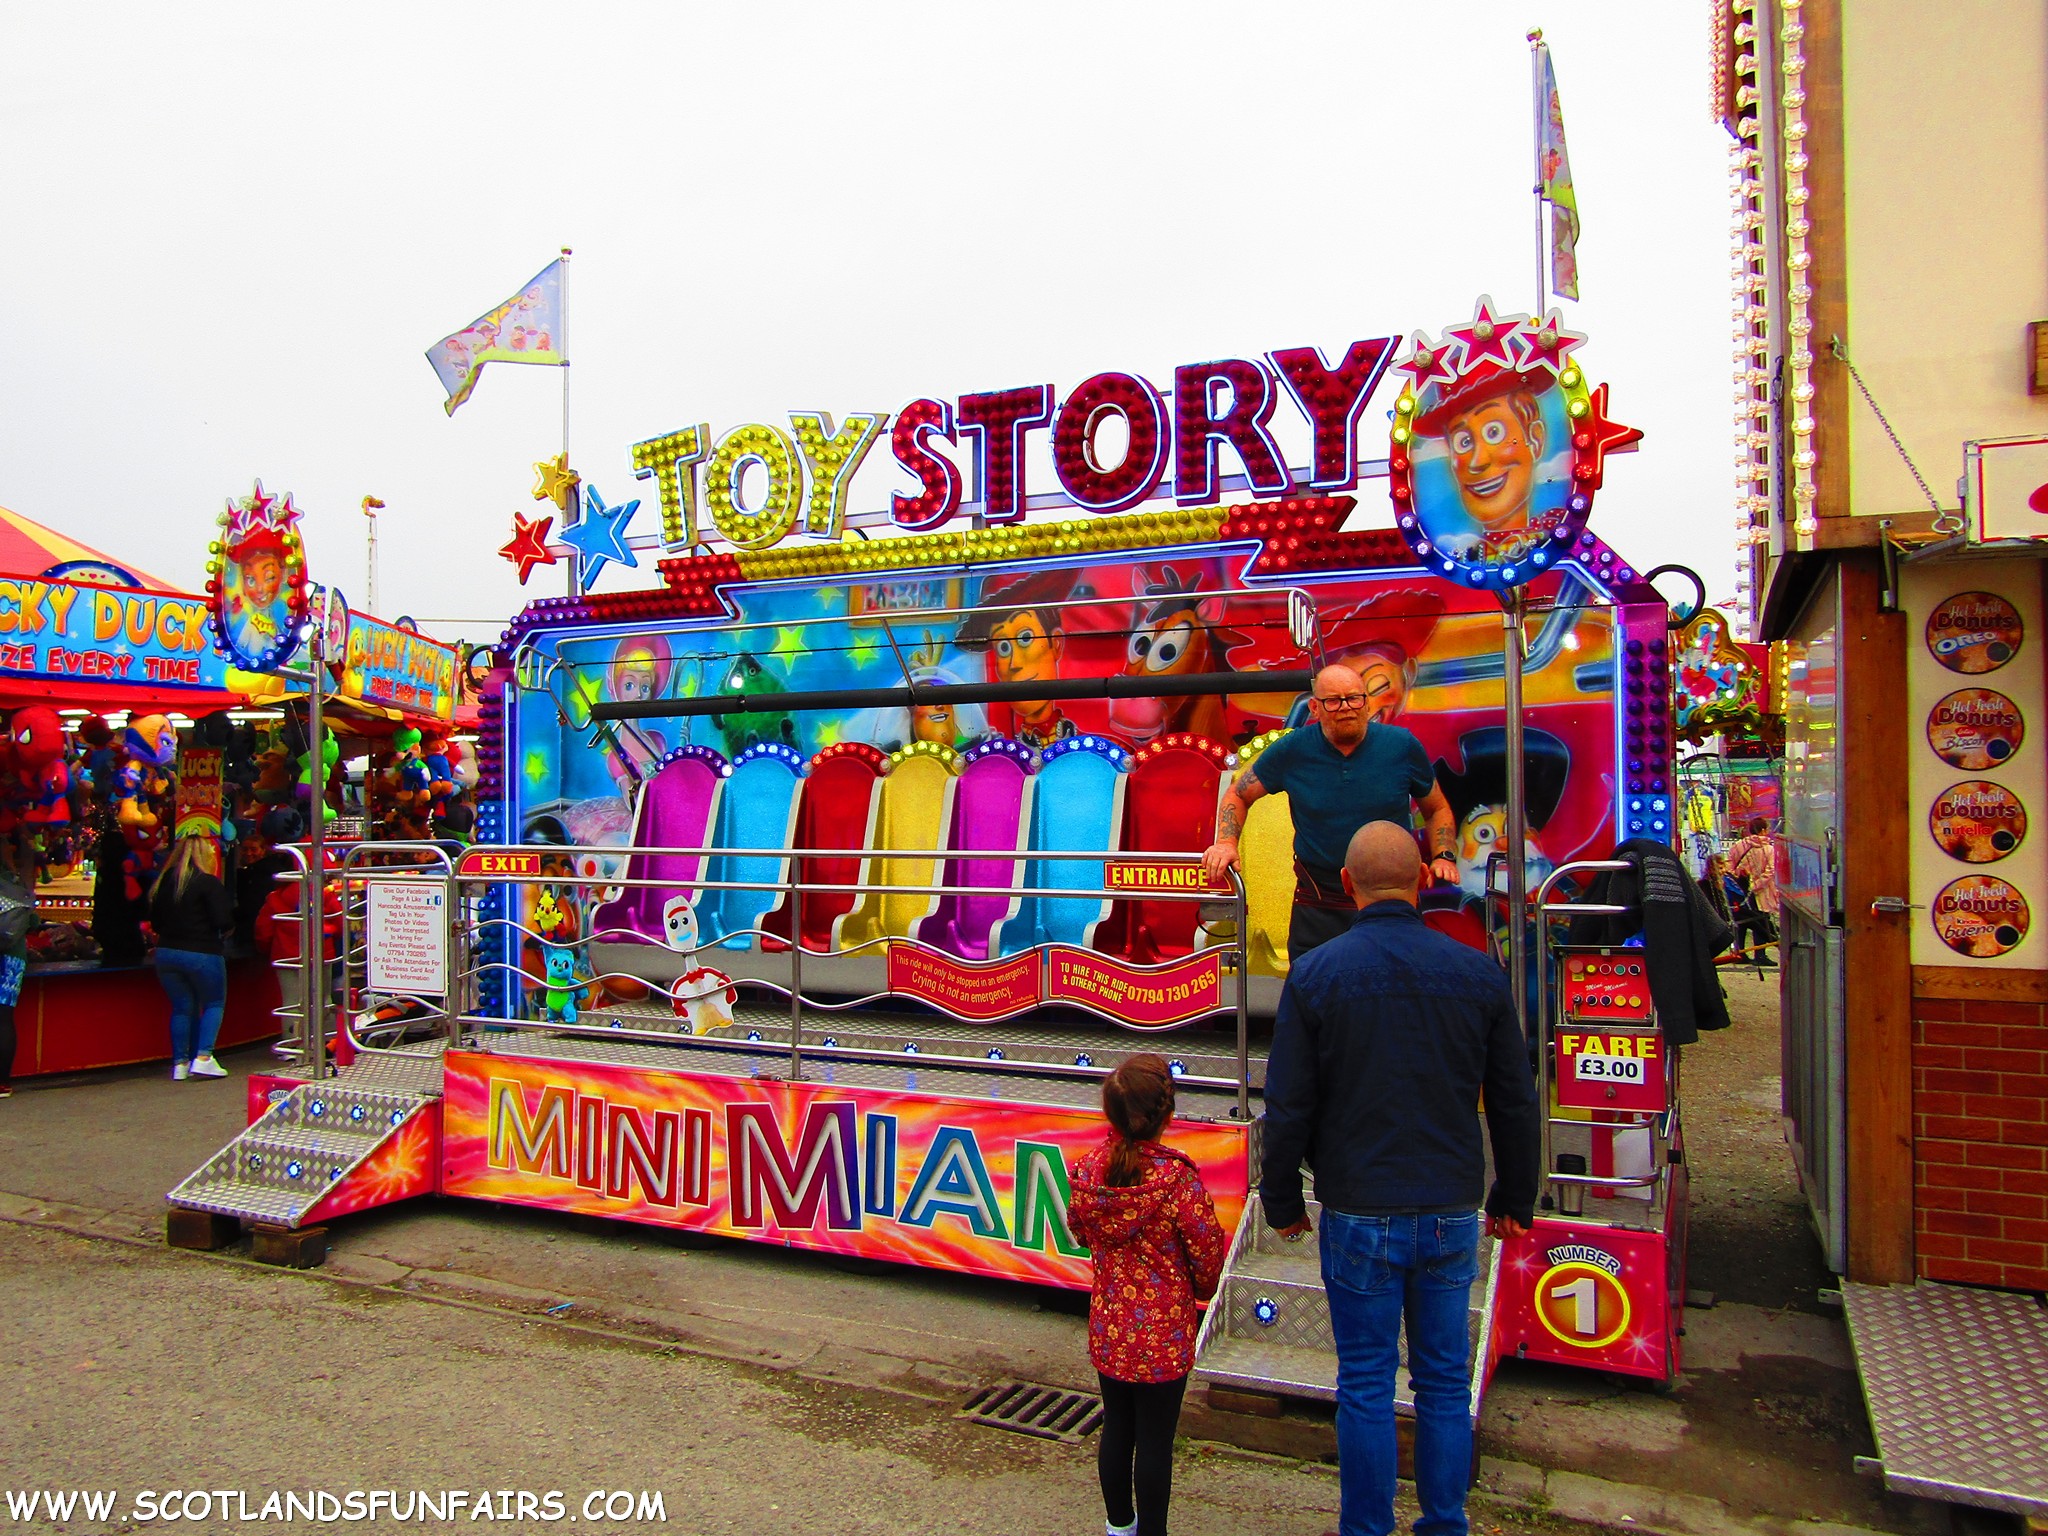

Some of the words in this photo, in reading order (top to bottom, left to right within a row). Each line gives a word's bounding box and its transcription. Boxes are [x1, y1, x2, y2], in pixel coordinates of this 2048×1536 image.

[627, 410, 889, 552] TOY
[890, 336, 1402, 530] STORY
[93, 589, 224, 658] DUCK
[1937, 612, 2015, 629] Donuts
[1936, 632, 1997, 655] OREO
[0, 642, 36, 671] ZE
[47, 646, 134, 679] EVERY
[143, 656, 201, 684] TIME
[1950, 701, 1970, 714] Hot
[1976, 698, 2004, 711] Fresh
[1938, 708, 2016, 727] Donuts
[181, 757, 222, 777] LUCKY
[1951, 794, 1971, 808] Hot
[1976, 790, 2004, 803] Fresh
[1940, 802, 2017, 818] Donuts
[1943, 824, 1992, 835] nutella
[481, 857, 530, 871] EXIT
[1112, 867, 1208, 886] ENTRANCE
[1942, 895, 2020, 912] Donuts
[1954, 888, 1973, 902] Hot
[1979, 885, 2008, 898] Fresh
[1944, 924, 1995, 939] bueno
[896, 954, 909, 966] This
[910, 957, 922, 968] ride
[923, 963, 933, 973] will
[934, 967, 947, 980] only
[948, 970, 956, 982] be
[956, 976, 979, 989] stopped
[981, 977, 987, 986] in
[988, 978, 996, 986] an
[996, 965, 1030, 983] emergency.
[1060, 962, 1070, 973] TO
[1073, 964, 1090, 977] HIRE
[1093, 970, 1110, 985] THIS
[1111, 978, 1128, 993] RIDE
[912, 971, 937, 993] Crying
[938, 980, 945, 993] is
[946, 986, 960, 999] not
[960, 992, 970, 1002] an
[971, 986, 1013, 1004] emergency.
[1062, 974, 1068, 985] &
[1070, 976, 1097, 992] OTHERS
[1099, 985, 1123, 1003] PHONE
[1127, 985, 1164, 1004] 07794
[1166, 983, 1190, 1002] 730
[1191, 970, 1217, 994] 265
[1585, 983, 1603, 991] Mini
[1562, 1035, 1657, 1058] FARE
[1580, 1059, 1638, 1078] £3.00
[487, 1077, 712, 1209] MINI
[1547, 1245, 1621, 1275] NUMBER
[1551, 1277, 1597, 1335] 1
